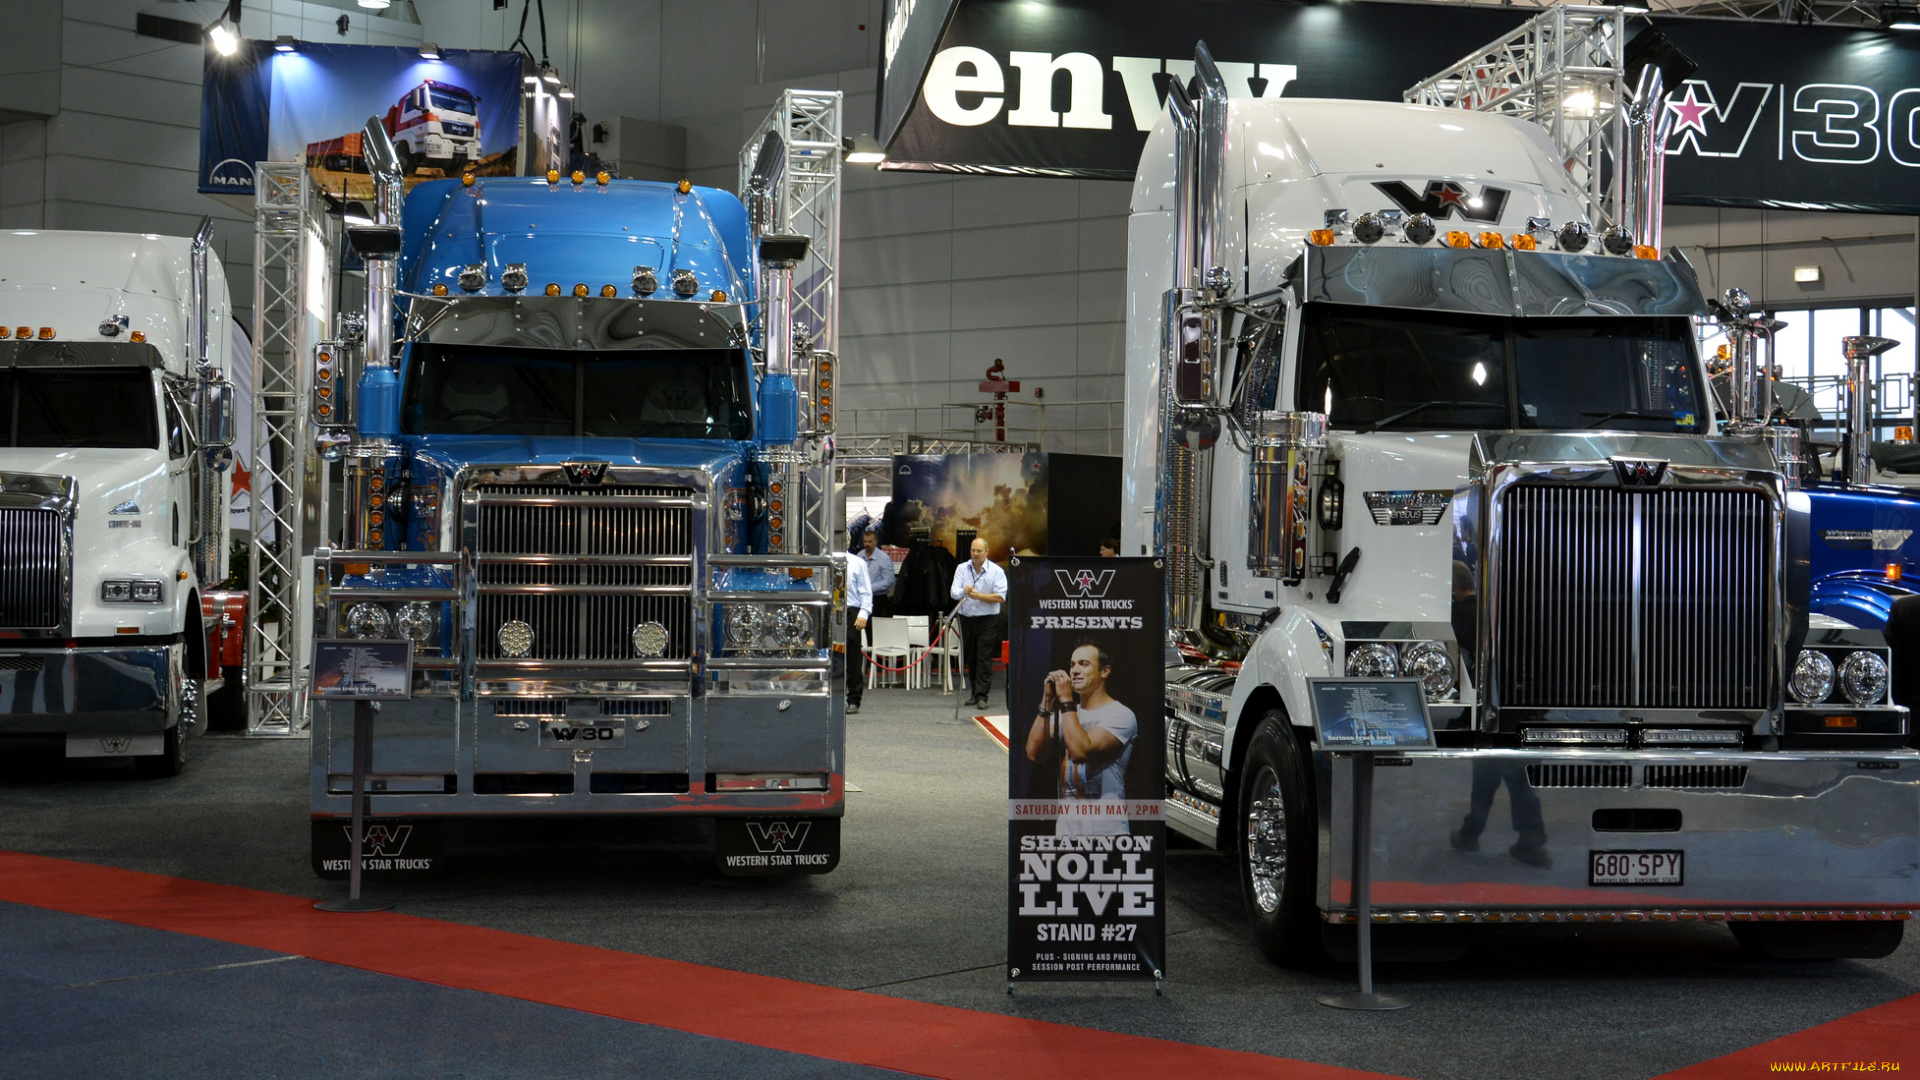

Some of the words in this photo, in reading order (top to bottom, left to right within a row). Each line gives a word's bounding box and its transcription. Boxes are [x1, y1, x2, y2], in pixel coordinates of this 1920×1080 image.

[213, 176, 253, 186] MAN
[1038, 599, 1078, 610] WESTERN
[1079, 599, 1100, 610] STAR
[1101, 599, 1133, 610] TRUCKS
[1030, 616, 1143, 629] PRESENTS
[1016, 804, 1071, 816] SATURDAY
[1075, 804, 1102, 816] 18TH
[1105, 804, 1131, 817] MAY,
[1135, 804, 1160, 816] 2PM
[1020, 834, 1154, 851] SHANNON
[322, 859, 367, 871] WESTN
[368, 859, 392, 870] STAR
[394, 858, 430, 870] TRUCKS
[726, 855, 769, 867] WESTERN
[770, 855, 792, 866] STAR
[794, 854, 828, 866] TRUCKS
[1019, 853, 1154, 881] NOLL
[1018, 884, 1155, 916] LIVE
[1036, 923, 1096, 942] STAND
[1100, 923, 1138, 942] #27
[1036, 952, 1055, 961] PLUS
[1062, 952, 1094, 961] SIGNING
[1096, 952, 1111, 961] AND
[1113, 952, 1137, 961] PHOTO
[1031, 963, 1064, 971] SESSION
[1066, 963, 1085, 971] POST
[1087, 963, 1141, 971] PERFORMANCE
